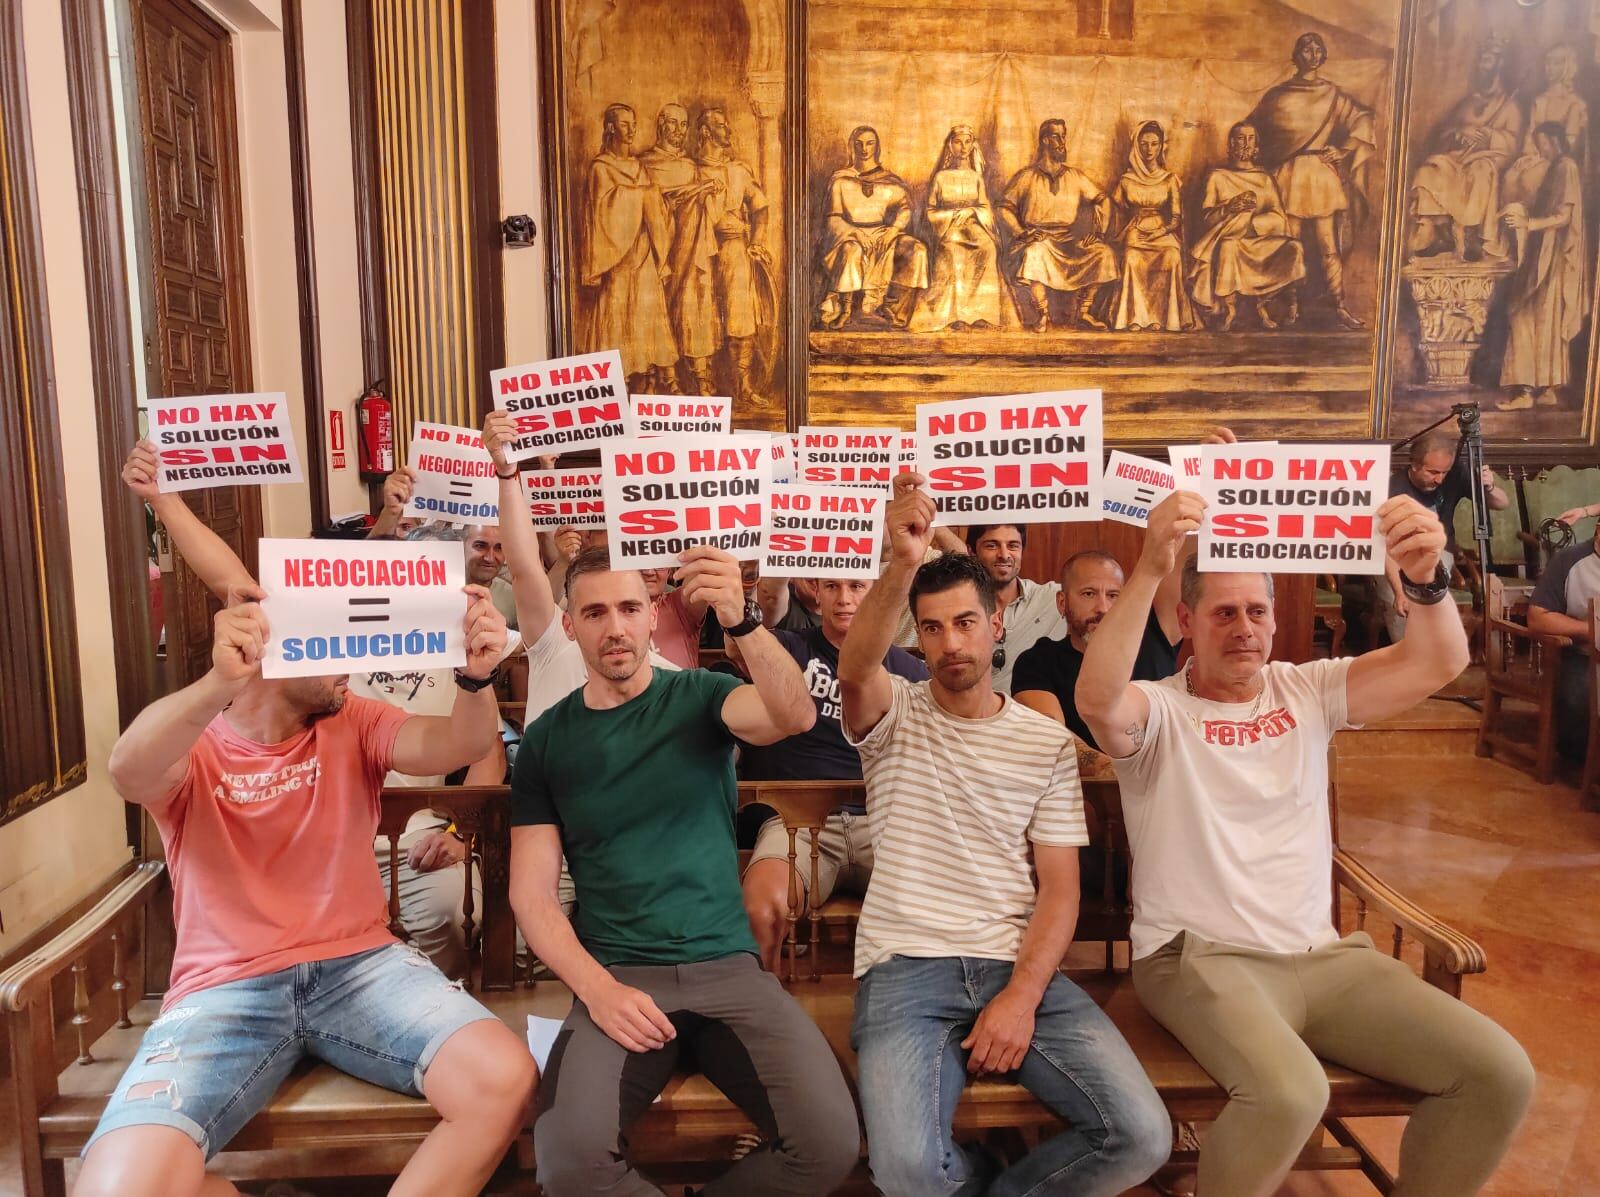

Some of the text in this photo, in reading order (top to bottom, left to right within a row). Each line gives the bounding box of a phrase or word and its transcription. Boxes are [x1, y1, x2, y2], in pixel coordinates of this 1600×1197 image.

[500, 362, 611, 395] NO HAY
[506, 385, 615, 412] SOLUCIÓN
[157, 403, 277, 425] NO HAY
[512, 402, 621, 434] SIN
[638, 403, 724, 417] NO HAY
[929, 405, 1088, 436] NO HAY
[161, 425, 279, 444] SOLUCIÓN
[640, 420, 722, 432] SOLUCIÓN
[420, 428, 485, 449] NO HA
[510, 423, 624, 451] NEGOCIACIÓN
[805, 435, 893, 448] NO HAY
[934, 434, 1085, 459] SOLUCIÓN
[160, 444, 287, 465] SIN
[615, 451, 675, 476] NO
[688, 449, 761, 472] HAY
[808, 452, 890, 463] SOLUCIÓN
[165, 462, 292, 481] NEGOCIACIÓN
[805, 467, 890, 482] SIN
[929, 462, 1088, 491] SIN
[1213, 458, 1273, 480] NO
[1288, 459, 1376, 481] HAY
[528, 475, 602, 488] NO HAY
[622, 477, 760, 501] SOLUCIÓN
[531, 488, 602, 500] SOLUCIÓN
[771, 494, 877, 513] NO HAY
[931, 489, 1089, 512] NEGOCIACIÓN
[1217, 487, 1371, 507] SOLUCIÓN
[414, 496, 499, 517] SOLUCIÓN
[530, 501, 604, 515] SIN
[532, 514, 606, 526] NEGOCIACIÓN
[619, 503, 761, 535] SIN
[773, 516, 873, 531] SOLUCIÓN
[1212, 513, 1373, 539] SIN
[769, 534, 873, 554] SIN
[1210, 542, 1372, 560] NEGOCIACIÓN
[284, 555, 446, 588] NEGOCIACIÓN
[767, 555, 871, 569] NEGOCIACIÓN
[282, 629, 446, 662] SOLUCIÓN
